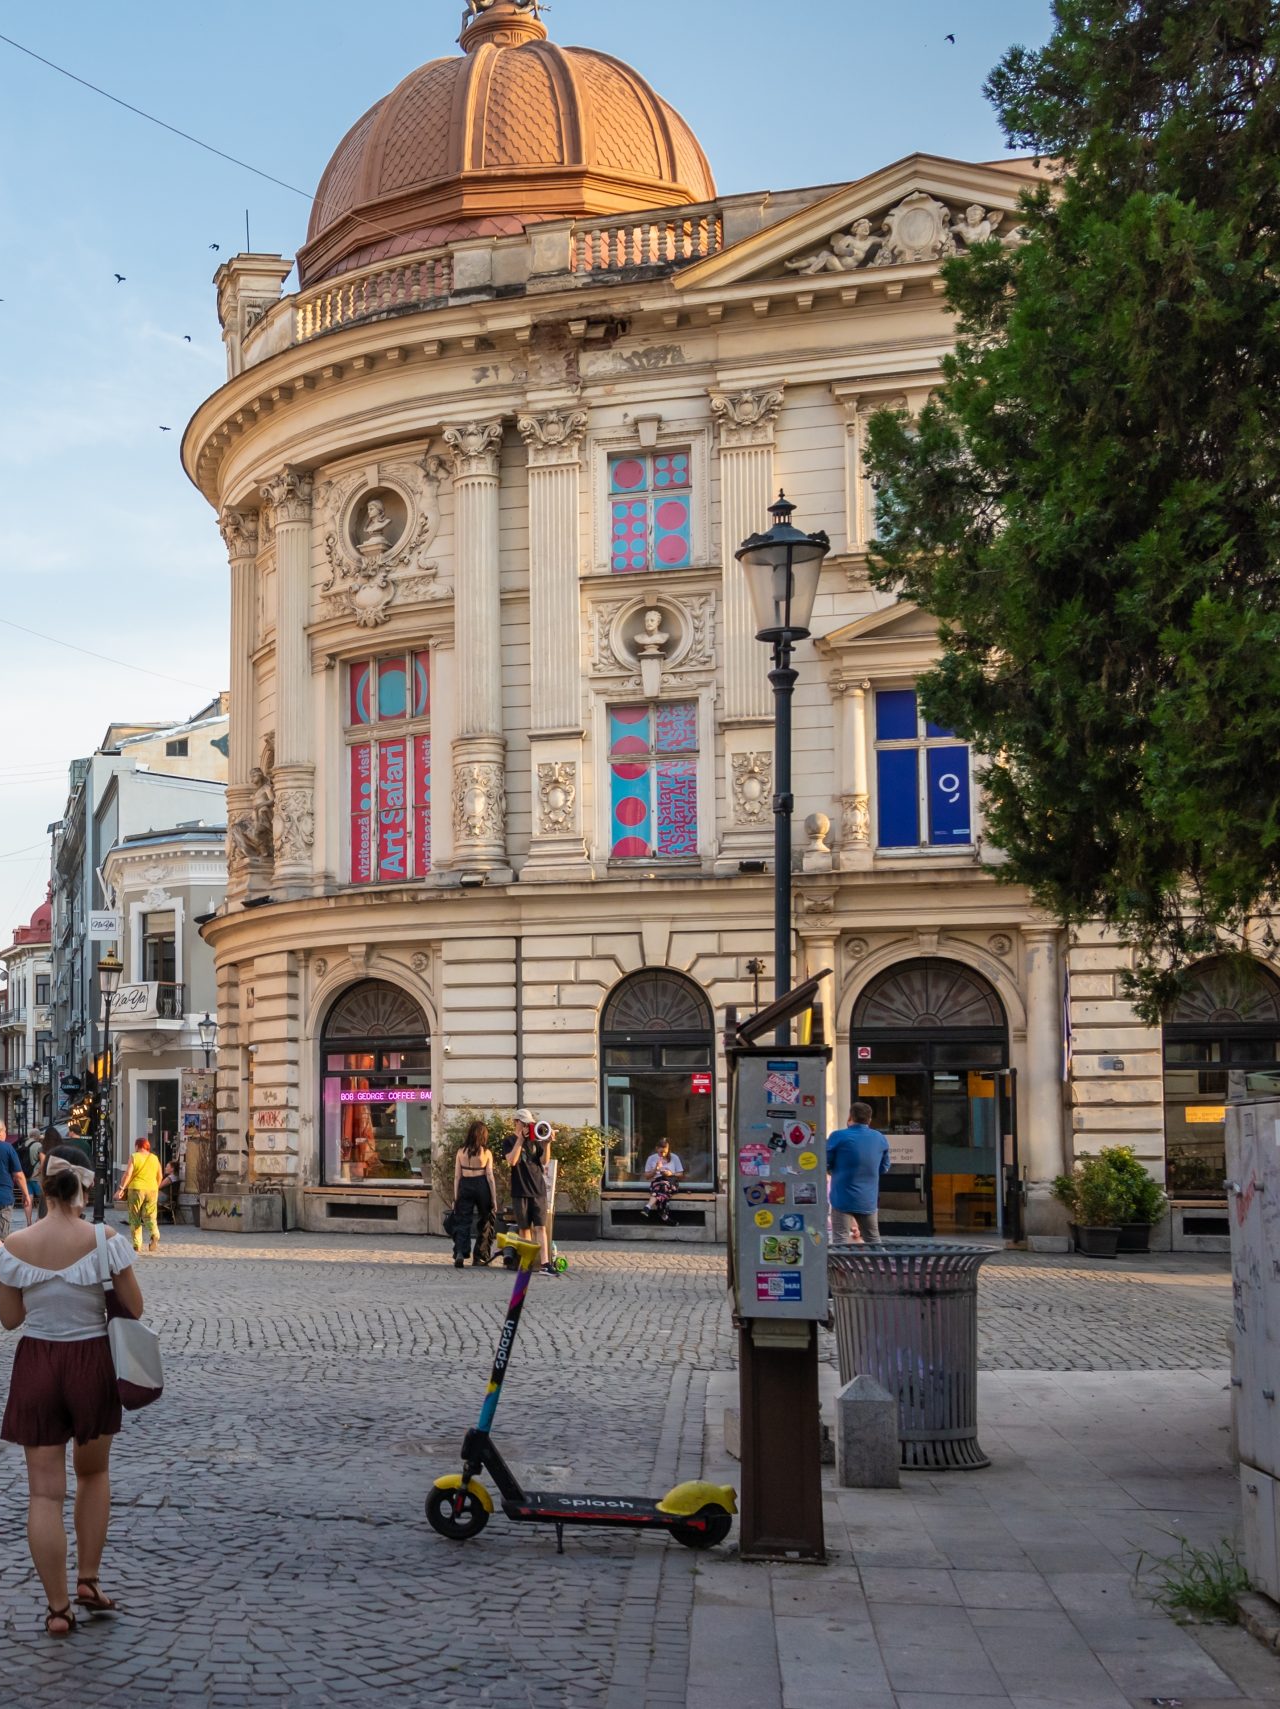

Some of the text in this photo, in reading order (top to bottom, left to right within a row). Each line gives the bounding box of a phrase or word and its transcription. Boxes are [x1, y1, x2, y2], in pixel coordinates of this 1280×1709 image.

[358, 748, 370, 777] visit
[380, 744, 404, 874] Art Safari
[340, 1092, 354, 1101] BOB
[357, 1092, 384, 1100] GEORGE
[388, 1092, 416, 1100] COFFEE
[495, 1319, 515, 1369] splash
[558, 1498, 634, 1508] splash
